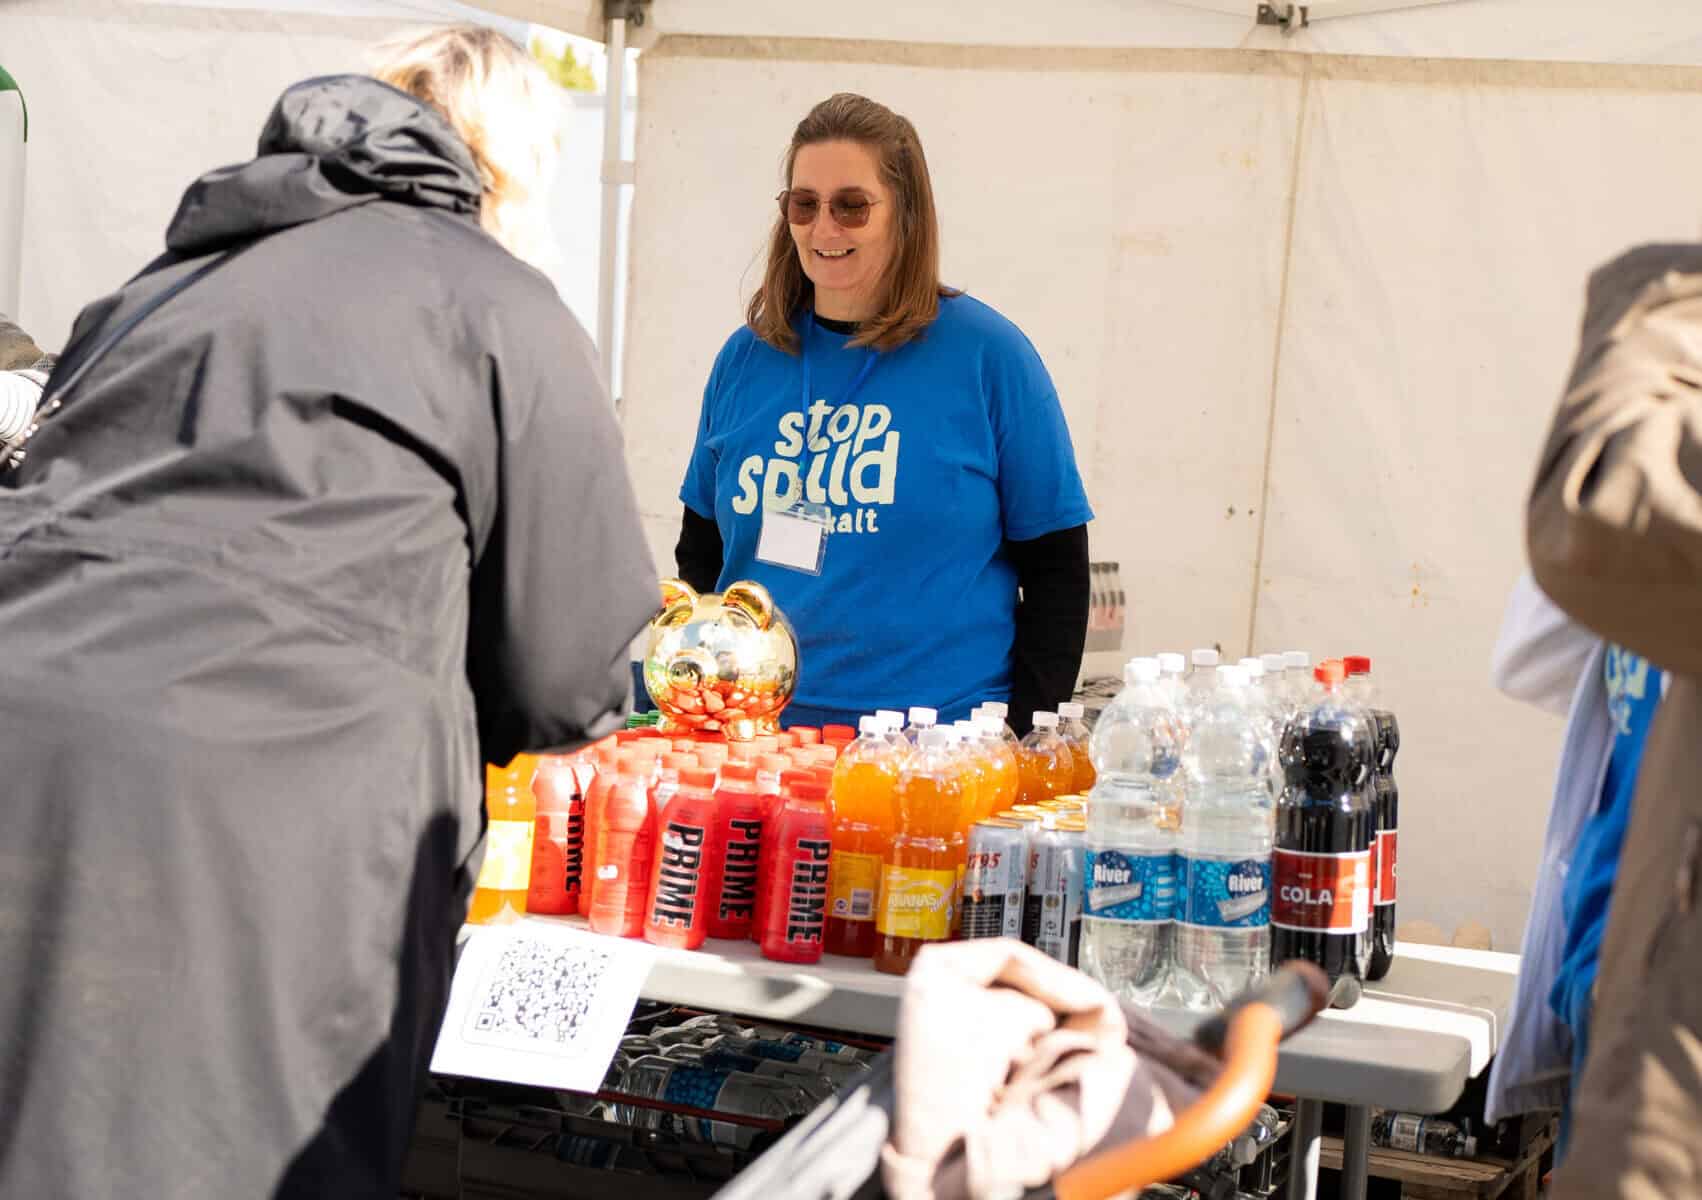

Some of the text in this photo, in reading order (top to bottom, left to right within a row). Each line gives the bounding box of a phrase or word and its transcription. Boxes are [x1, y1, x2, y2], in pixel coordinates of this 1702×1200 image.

[775, 399, 892, 457] stop
[652, 821, 704, 928] PRIME
[719, 818, 763, 920] PRIME
[785, 838, 832, 945] PRIME
[1094, 863, 1132, 884] River
[1228, 873, 1263, 892] River
[1279, 885, 1333, 906] COLA
